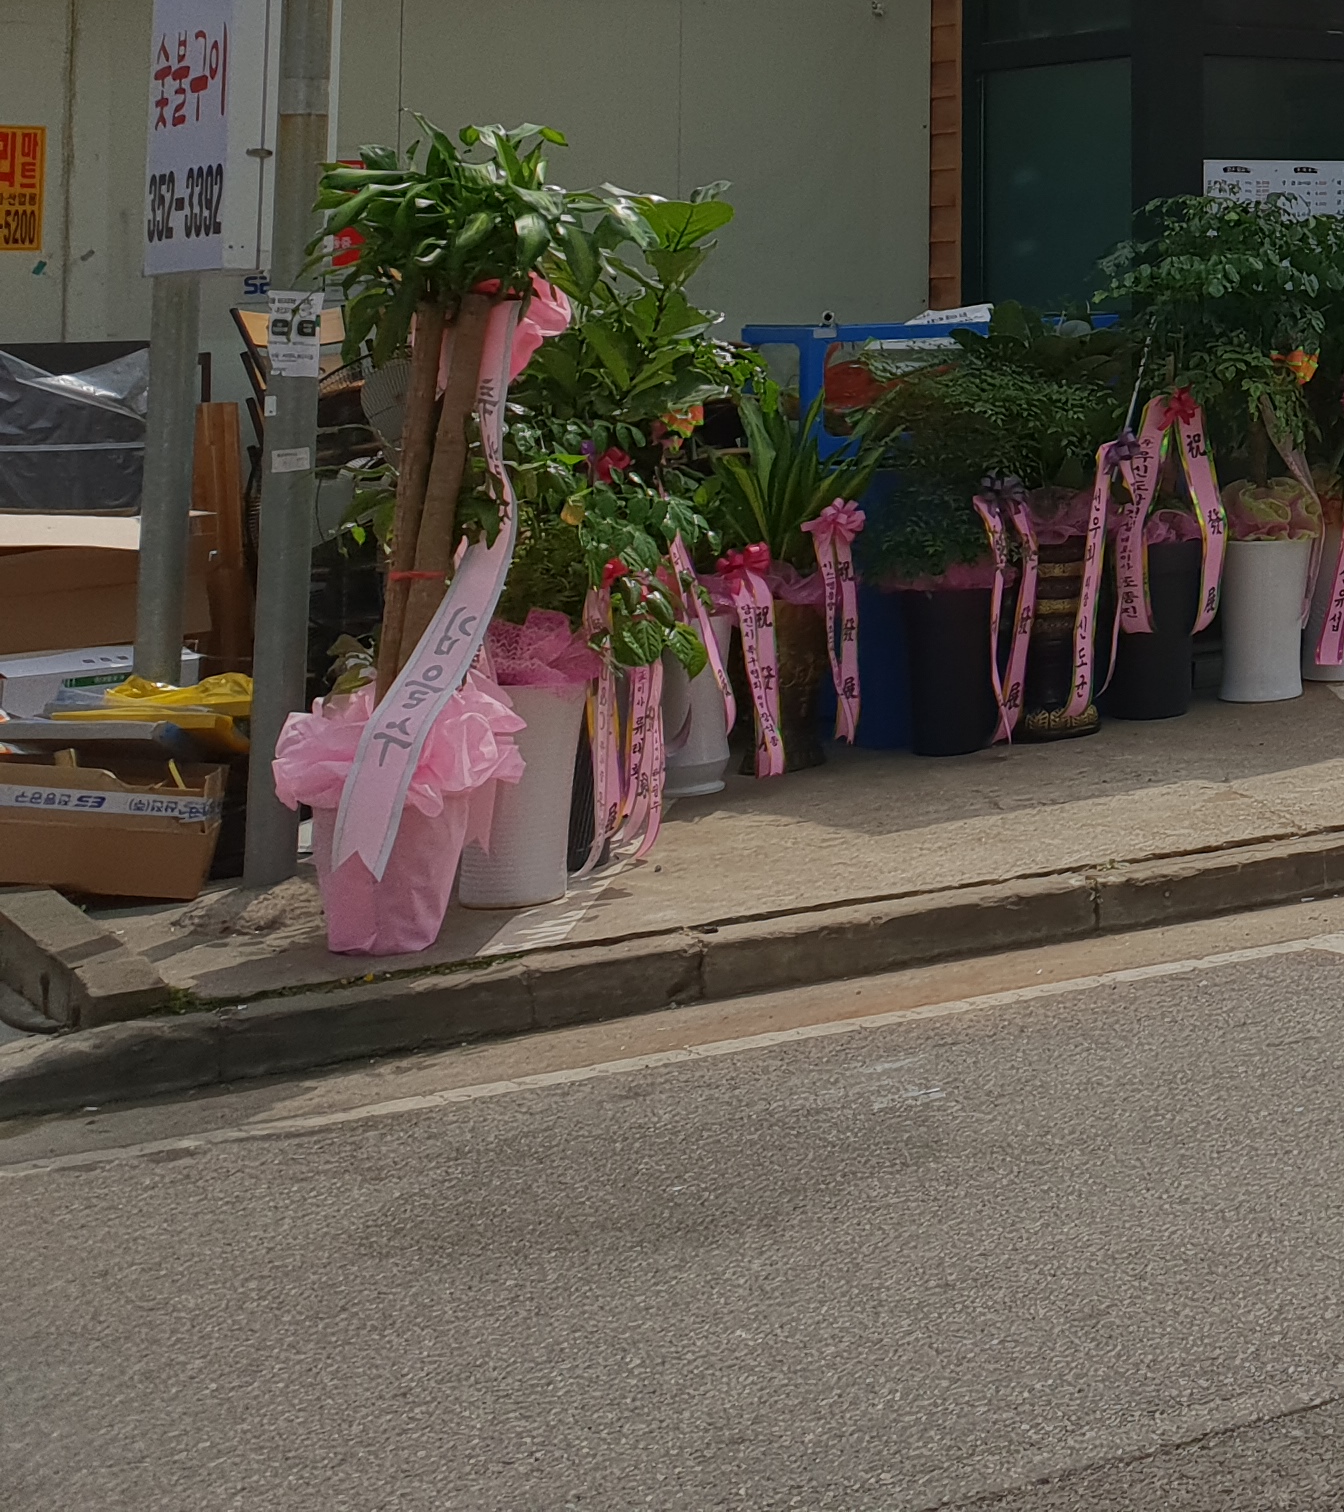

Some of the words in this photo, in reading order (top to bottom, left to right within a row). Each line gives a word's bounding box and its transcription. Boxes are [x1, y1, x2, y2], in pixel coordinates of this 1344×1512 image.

[154, 21, 228, 131] 숯불구이
[147, 163, 224, 244] 352-3392
[1186, 434, 1208, 459] 祝
